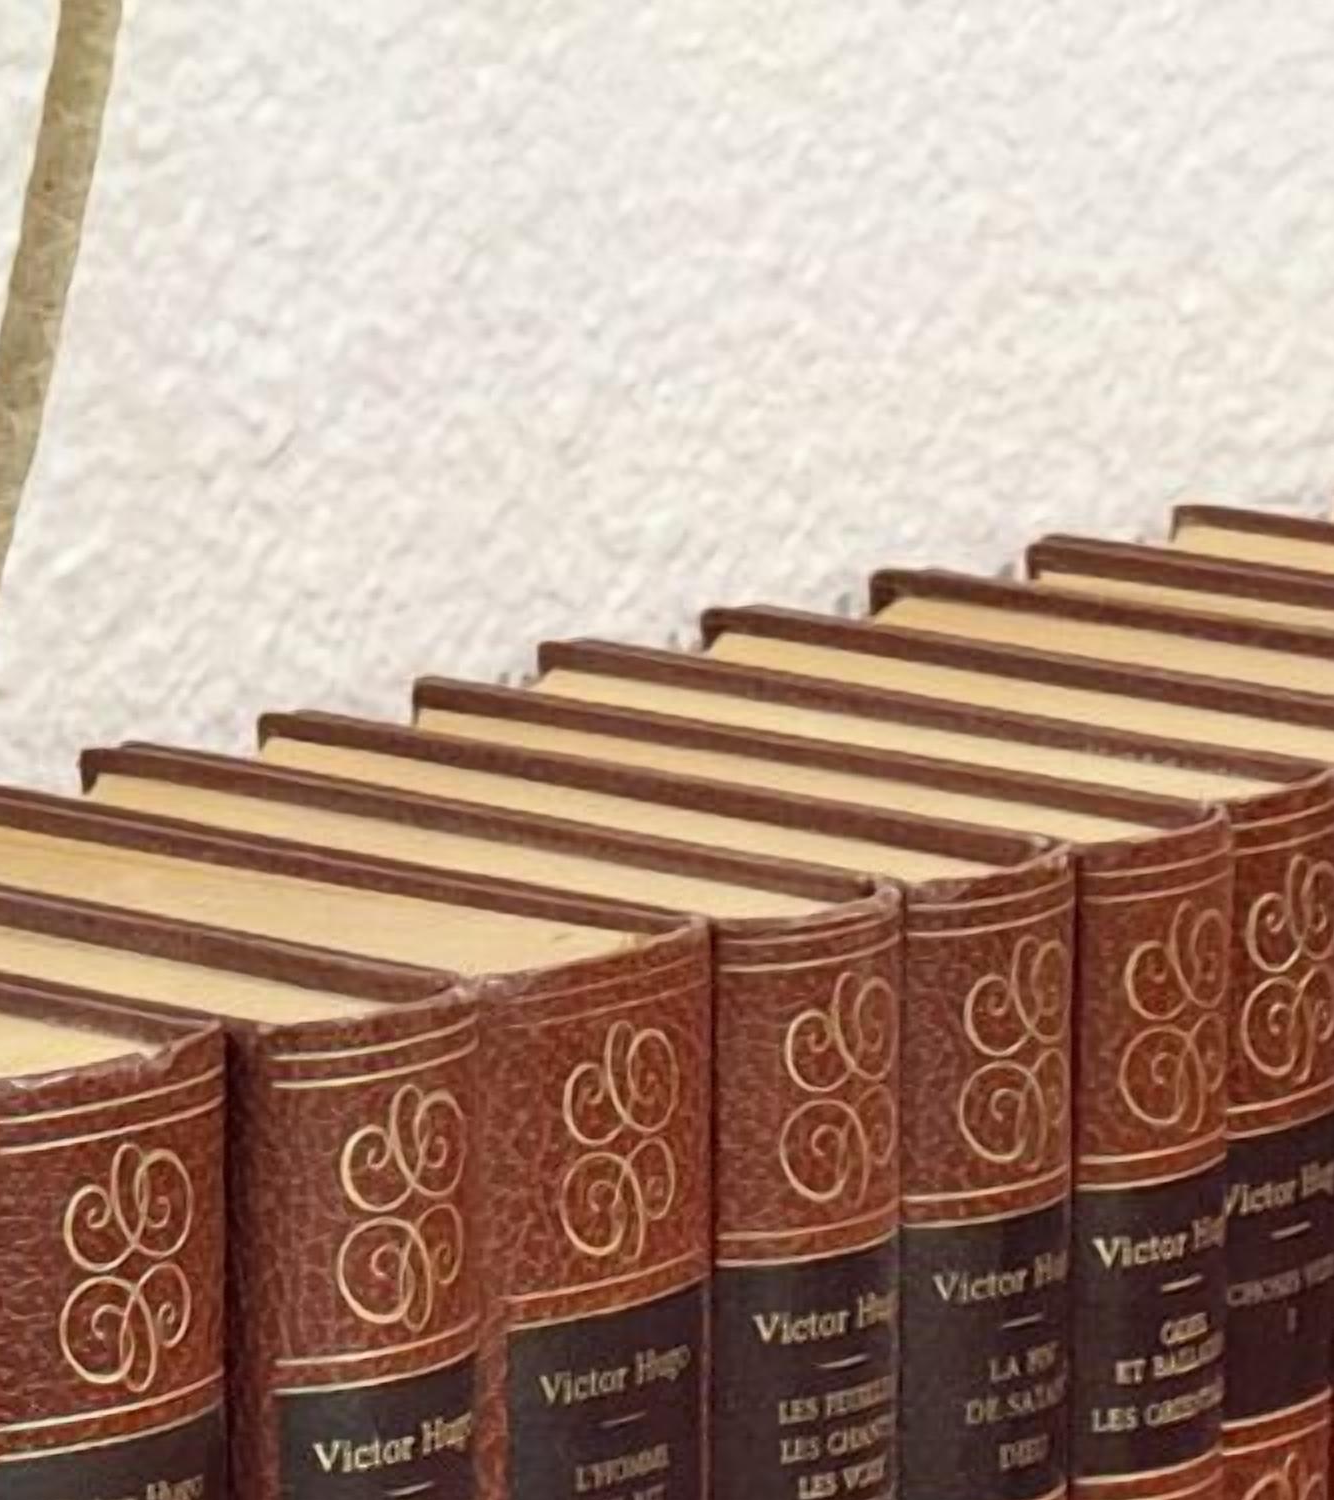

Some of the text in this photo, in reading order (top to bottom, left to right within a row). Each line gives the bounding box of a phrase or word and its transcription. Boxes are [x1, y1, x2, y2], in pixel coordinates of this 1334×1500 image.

[1092, 1231, 1188, 1268] Victor
[932, 1269, 1028, 1303] Victor
[753, 1311, 851, 1345] Victor
[538, 1367, 630, 1405] Victor
[778, 1396, 819, 1426] LES
[1091, 1405, 1140, 1433] LES
[312, 1435, 416, 1472] Victor
